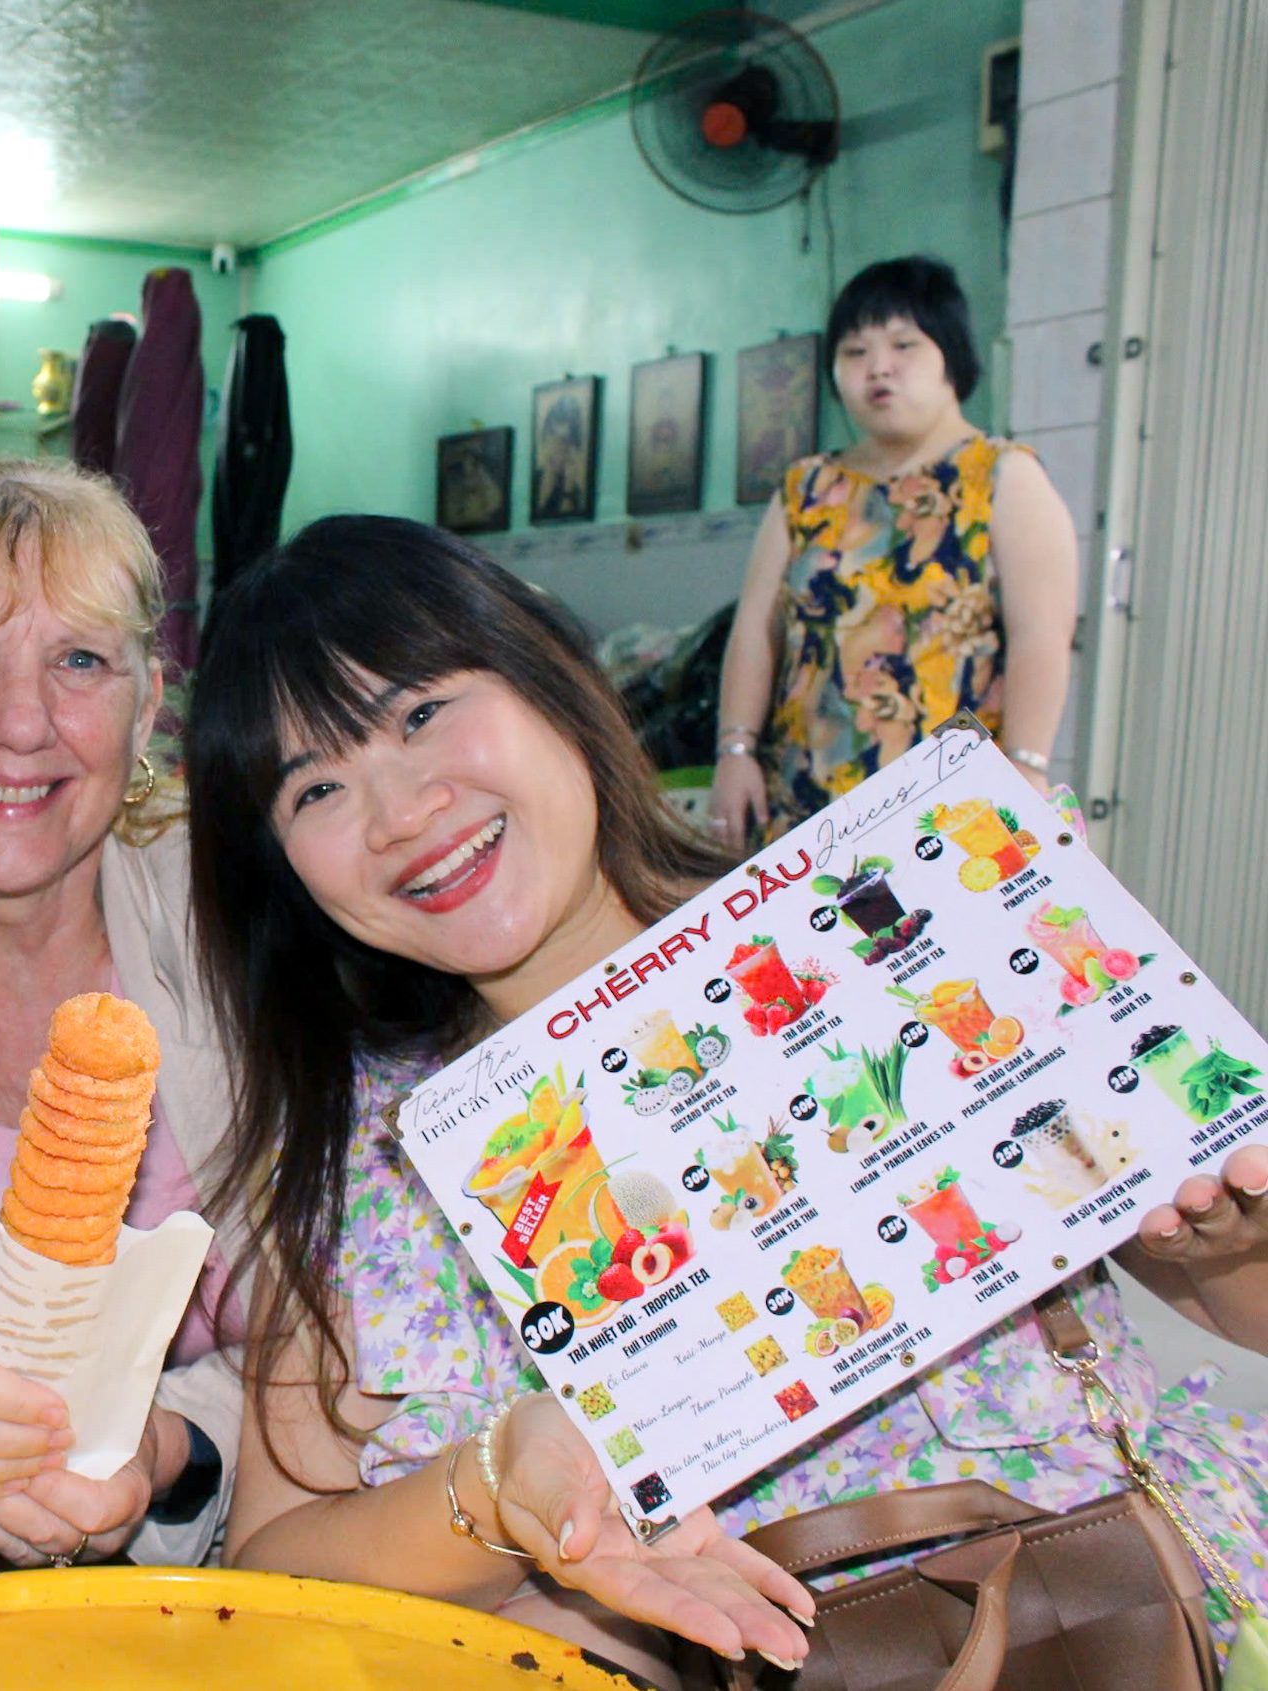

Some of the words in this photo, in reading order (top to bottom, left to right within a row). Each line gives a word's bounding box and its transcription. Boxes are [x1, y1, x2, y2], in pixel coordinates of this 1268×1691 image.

[815, 780, 918, 869] Juices
[922, 734, 982, 781] Tea
[917, 836, 943, 860] 25K
[999, 881, 1017, 897] TRÀ
[1014, 868, 1038, 888] THƠM
[1003, 884, 1038, 911] PINAPPLE
[1035, 875, 1053, 890] TEA
[812, 907, 836, 930] 25K
[546, 912, 712, 1040] CHERRY
[886, 957, 903, 973] TRÀ
[892, 956, 932, 986] MULBERRY
[930, 946, 946, 961] TEA
[1011, 949, 1038, 973] 25K
[706, 979, 730, 1001] 25K
[1107, 990, 1126, 1006] TRÀ
[1110, 1001, 1138, 1023] GUAVA
[1134, 992, 1153, 1007] TEA
[781, 1026, 798, 1042] TRÀ
[782, 1025, 829, 1059] STRAWBERRY
[827, 1015, 844, 1030] TEA
[901, 1022, 927, 1045] 25K
[603, 1048, 627, 1070] 30K
[961, 1045, 1067, 1119] PEACH-ORANGE-LEMONGRASS
[972, 1075, 991, 1093] TRÀ
[1005, 1056, 1024, 1073] CAM
[1110, 1066, 1137, 1091] 25K
[418, 1111, 458, 1145] Trái
[457, 1093, 491, 1120] Cây
[670, 1101, 687, 1117] TRÀ
[670, 1109, 703, 1134] CUSTARD
[700, 1093, 724, 1114] APPLE
[722, 1084, 739, 1101] TEA
[791, 1095, 817, 1118] 30K
[1189, 1128, 1209, 1147] TRÀ
[1241, 1094, 1267, 1114] XANH
[850, 1169, 881, 1194] LONGAN
[883, 1148, 915, 1172] PANDAN
[913, 1130, 942, 1153] LEAVES
[940, 1121, 956, 1136] TEA
[994, 1141, 1021, 1166] 25K
[1188, 1147, 1212, 1168] MILK
[1209, 1131, 1238, 1154] GREEN
[1234, 1122, 1253, 1137] TEA
[859, 1152, 882, 1170] LONG
[684, 1167, 709, 1189] 30K
[513, 1196, 537, 1234] BEST
[518, 1194, 551, 1245] SELLER
[1061, 1211, 1081, 1230] TRÀ
[1097, 1206, 1122, 1226] MILK
[1119, 1197, 1137, 1213] TEA
[750, 1220, 772, 1239] LONG
[757, 1228, 788, 1251] LONGAN
[785, 1218, 802, 1233] TEA
[799, 1207, 820, 1223] THAI
[880, 1216, 906, 1241] 25K
[972, 1268, 990, 1286] TRÀ
[975, 1279, 1005, 1303] LYCHEE
[1002, 1270, 1021, 1285] TEA
[767, 1287, 794, 1312] 30K
[523, 1304, 572, 1350] 30K
[567, 1342, 591, 1365] TRÀ
[641, 1281, 692, 1319] TROPICAL
[688, 1267, 711, 1289] TEA
[621, 1339, 642, 1357] Full
[638, 1316, 678, 1348] Topping
[829, 1352, 893, 1396] MANGO-PASSION
[915, 1326, 933, 1342] TEA
[832, 1357, 851, 1376] TRÀ
[867, 1331, 895, 1354] CHANH
